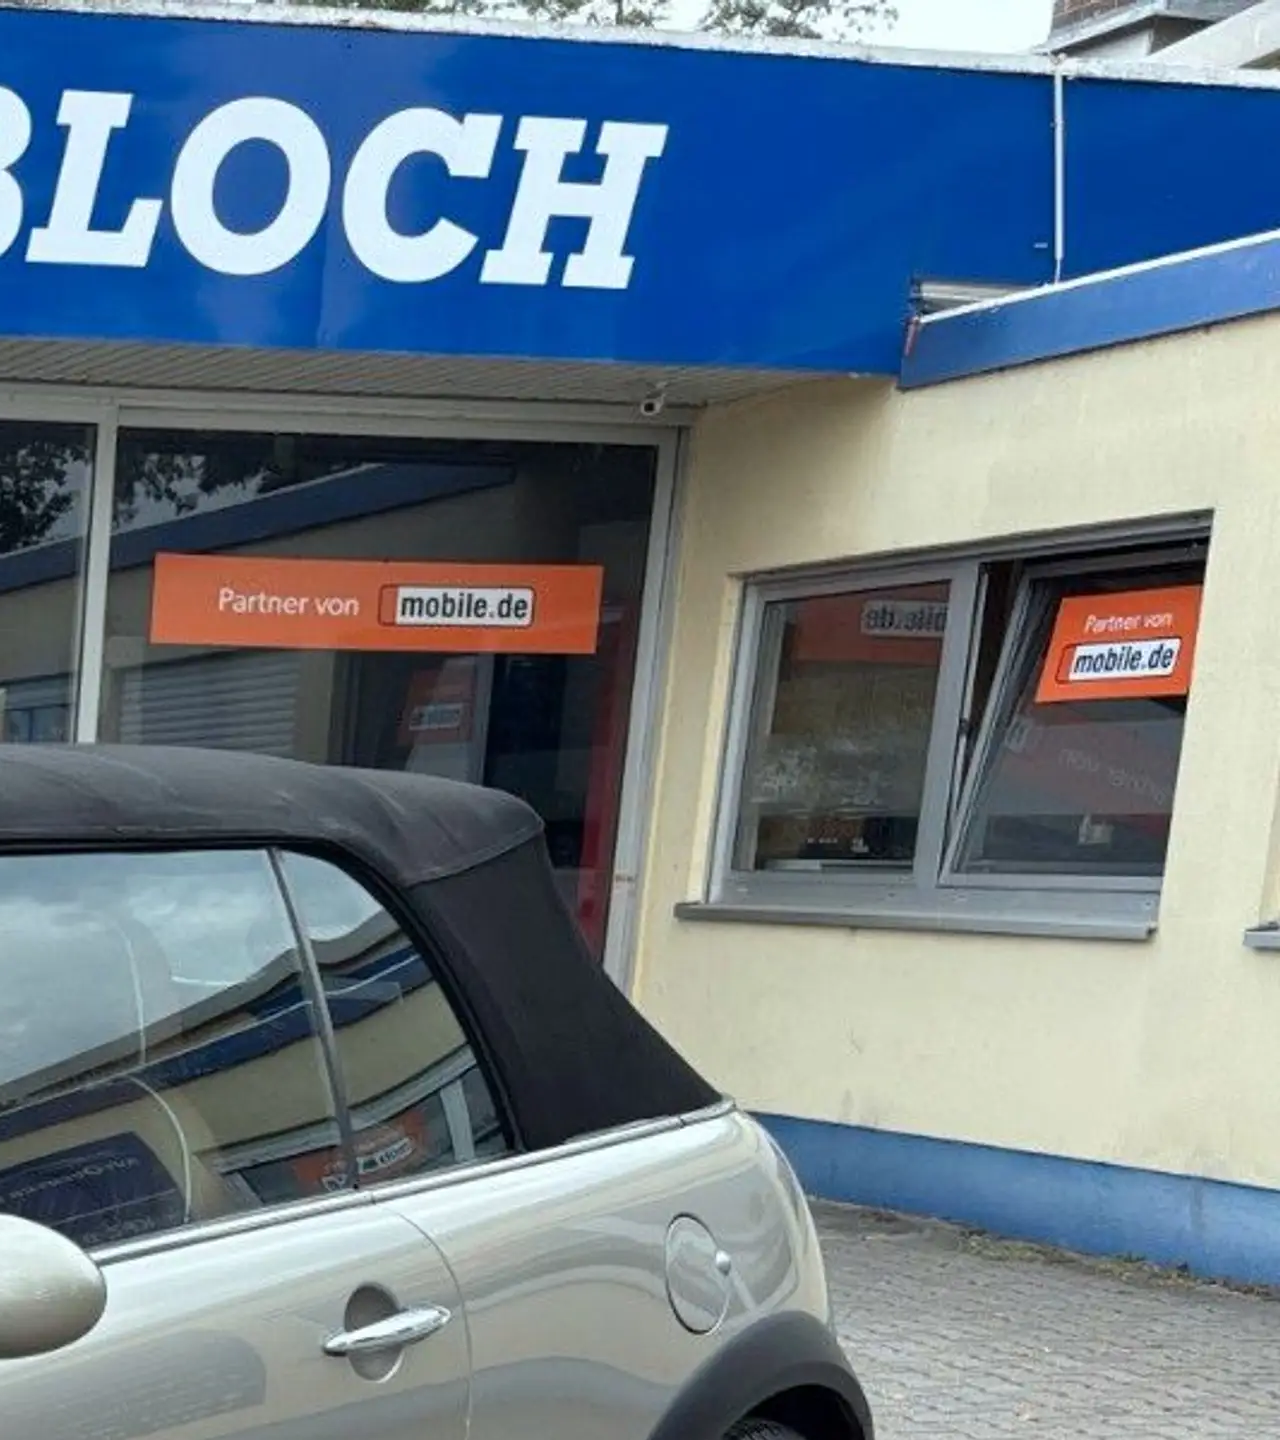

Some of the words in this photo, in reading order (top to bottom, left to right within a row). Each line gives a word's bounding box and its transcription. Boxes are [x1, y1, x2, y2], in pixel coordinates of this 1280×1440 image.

[218, 587, 309, 615] Partner
[315, 596, 360, 616] von
[399, 592, 529, 619] mobile.de
[1083, 613, 1142, 634] Partner
[1143, 612, 1174, 629] von
[1073, 643, 1175, 674] mobile.de
